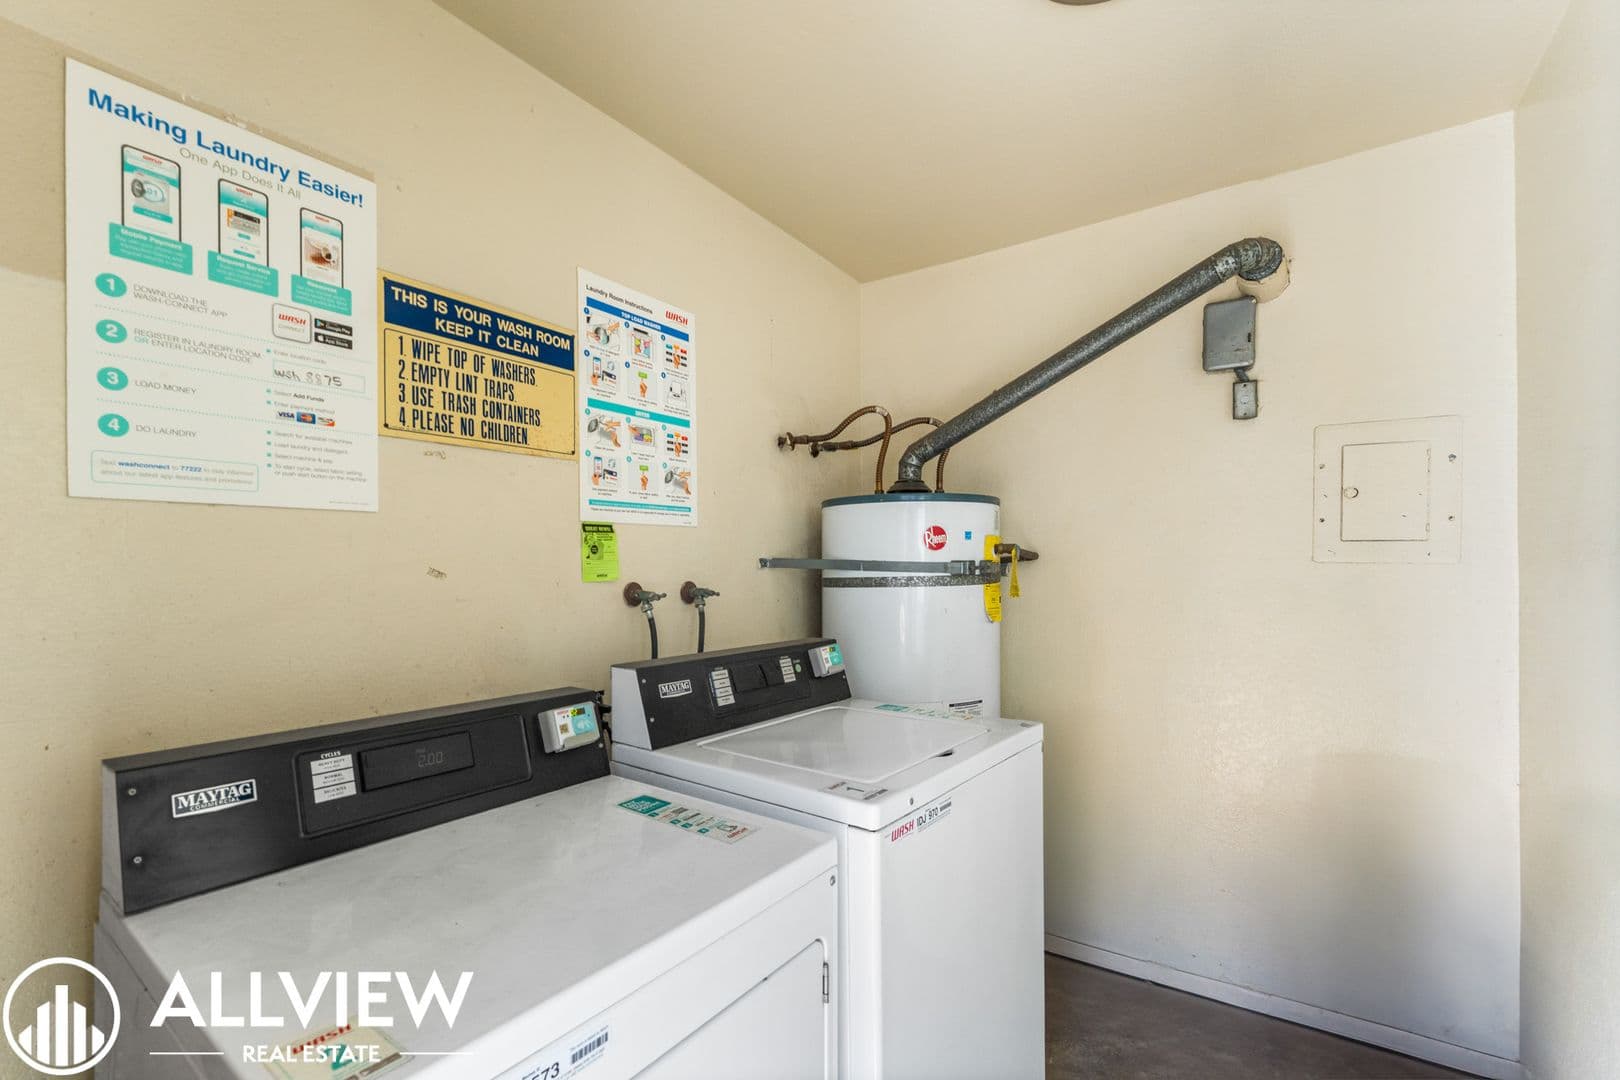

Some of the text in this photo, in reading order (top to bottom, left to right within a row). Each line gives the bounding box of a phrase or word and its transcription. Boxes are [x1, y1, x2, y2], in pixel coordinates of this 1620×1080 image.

[87, 87, 364, 208] Making Laundry Easier!
[179, 146, 209, 167] One
[213, 160, 238, 177] App
[242, 170, 273, 190] Does
[276, 181, 284, 193] It
[287, 186, 301, 200] All
[106, 278, 116, 292] 1
[133, 283, 208, 307] DOWNLOAD THE
[586, 284, 653, 315] Laundry Room Instructions
[210, 309, 229, 318] APP
[278, 313, 307, 326] WASH
[391, 286, 428, 309] THIS
[434, 298, 448, 315] IS
[454, 305, 492, 327] YOUR
[496, 317, 532, 339] WASH
[536, 329, 571, 351] ROOM
[665, 310, 689, 326] WASH
[105, 323, 118, 338] 2
[435, 317, 539, 357] KEEP IT CLEAN
[133, 328, 180, 343] REGISTER
[181, 336, 191, 346] IN
[193, 338, 236, 353] LAUNDRY
[134, 336, 252, 364] OR ENTER LOCATION CODE
[398, 335, 538, 387] 1. WIPE TOP OF WASHERS.
[106, 371, 119, 385] 3
[305, 371, 343, 387] 8875
[398, 360, 517, 403] 2. EMPTY LINT TRAPS.
[134, 379, 197, 395] LOAD MONEY
[293, 392, 306, 400] Add
[306, 395, 325, 403] Funds
[398, 383, 409, 405] 3.
[411, 385, 434, 409] USE
[442, 390, 477, 416] TRASH
[278, 411, 296, 419] VISA
[107, 418, 121, 432] 4
[135, 424, 198, 438] DO LAUNDRY
[398, 406, 530, 446] 4. PLEASE NO CHILDREN.
[118, 460, 171, 470] washconnect
[661, 681, 690, 693] MAYTAG
[320, 751, 341, 760] CYCLES
[177, 783, 252, 809] MAYTAG
[190, 797, 240, 812] COMMERCIAL
[890, 819, 915, 842] WASH
[928, 807, 939, 820] 970
